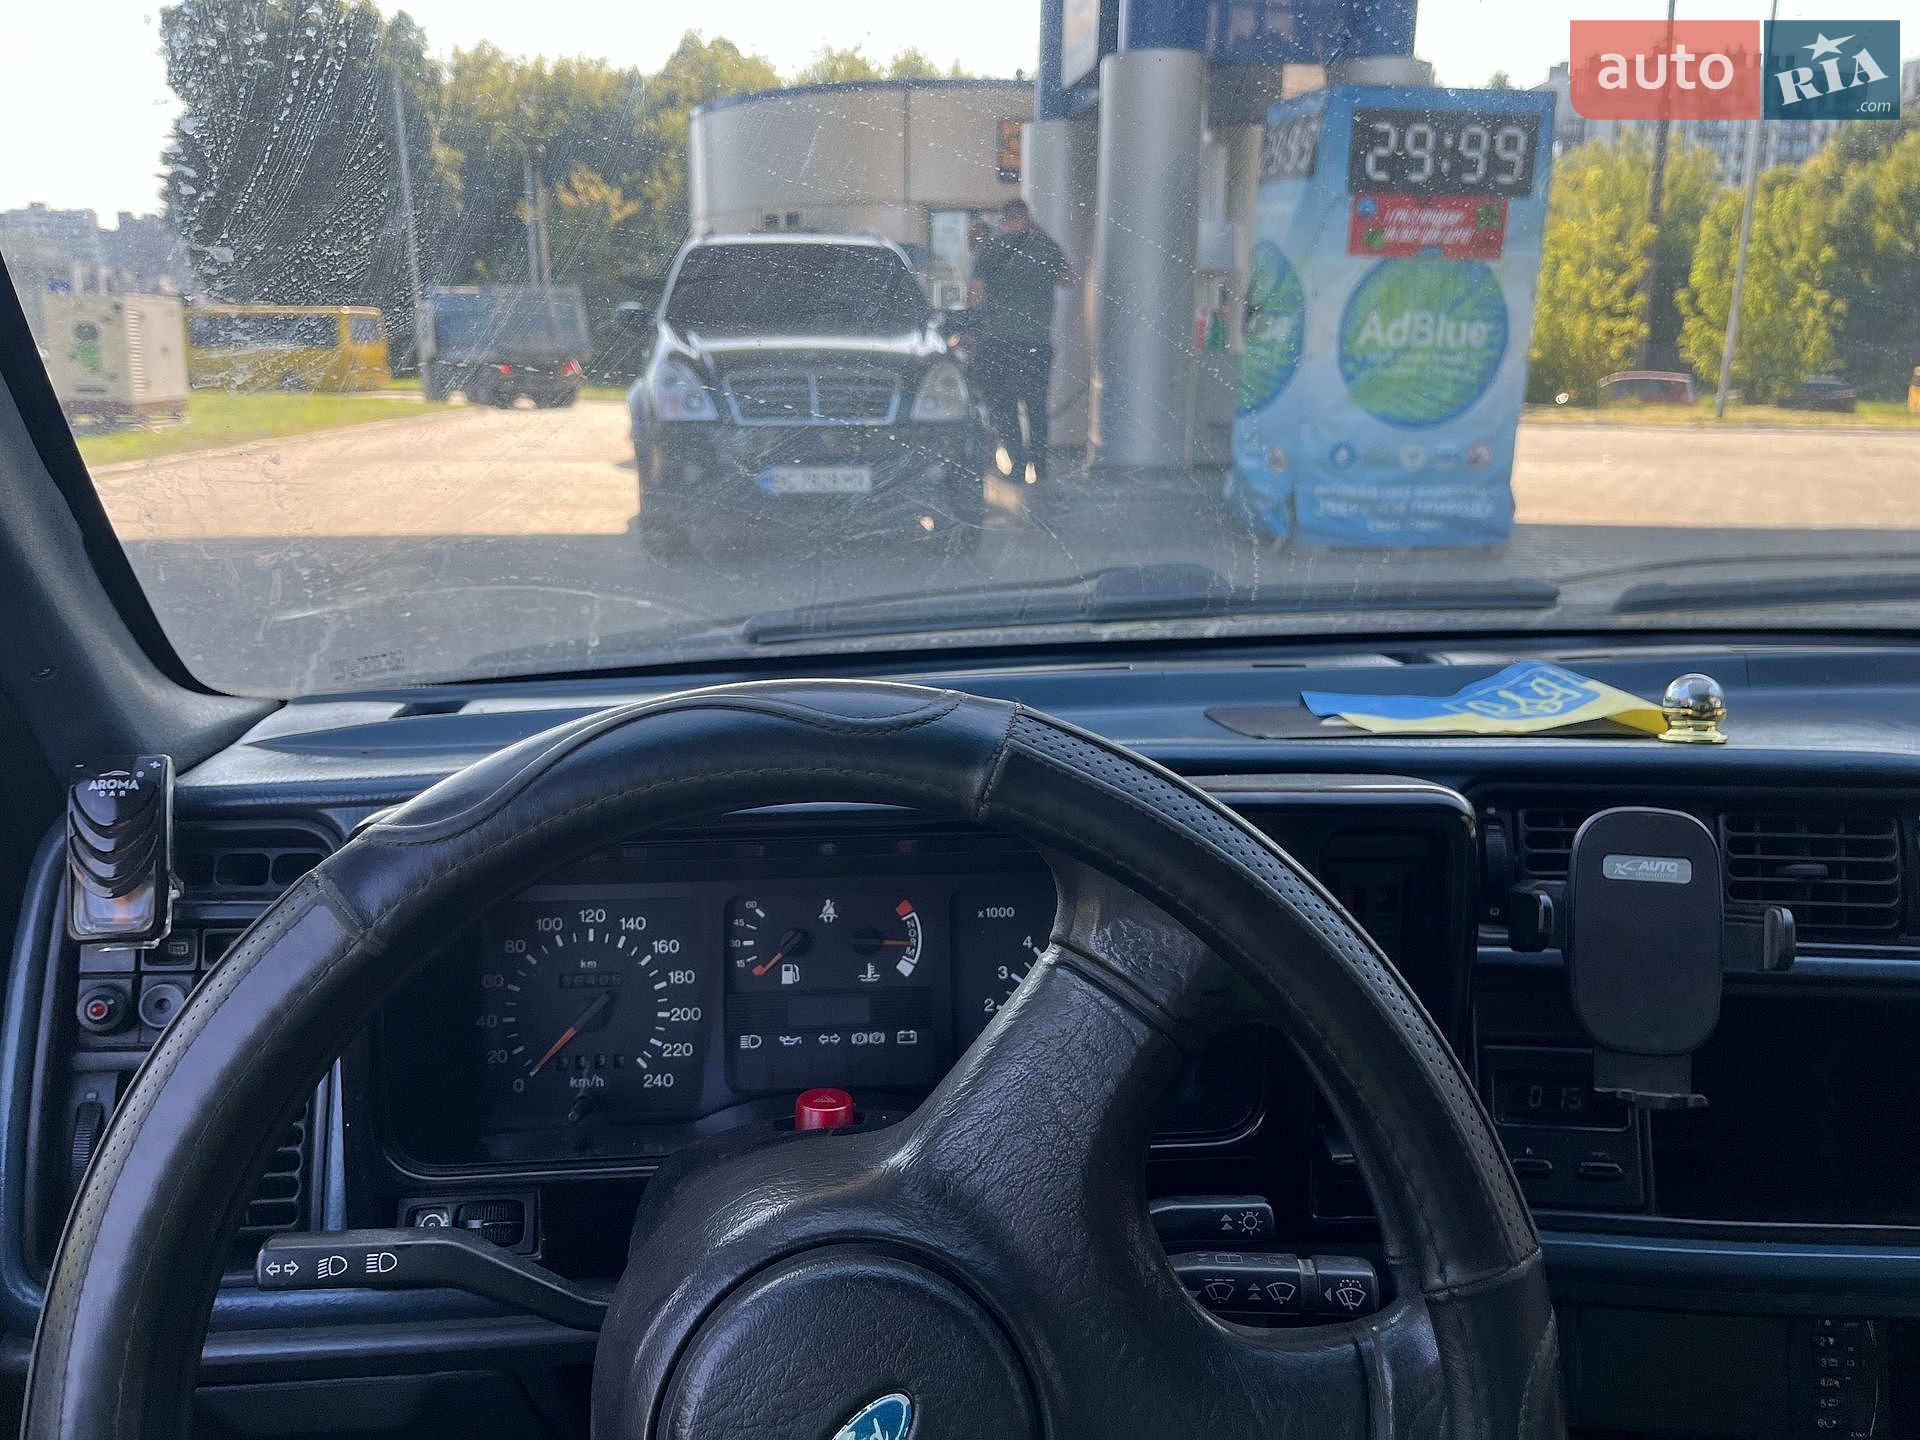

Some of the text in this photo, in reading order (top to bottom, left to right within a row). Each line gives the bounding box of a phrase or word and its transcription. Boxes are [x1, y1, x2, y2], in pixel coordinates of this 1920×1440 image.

[1358, 309, 1490, 348] AdBlue
[88, 779, 140, 791] AROMA
[745, 900, 758, 909] 60
[578, 908, 606, 923] 120
[977, 906, 1015, 918] x1000
[536, 917, 563, 931] 100
[619, 916, 647, 931] 140
[504, 939, 526, 953] 80
[652, 939, 680, 954] 160
[1022, 936, 1032, 949] 4
[580, 959, 597, 969] km
[668, 970, 695, 984] 180
[998, 966, 1008, 978] 3
[983, 999, 994, 1012] 2
[670, 1007, 701, 1021] 200
[487, 1050, 508, 1064] 20
[662, 1043, 693, 1057] 220
[569, 1075, 605, 1088] km/h
[643, 1074, 674, 1088] 240
